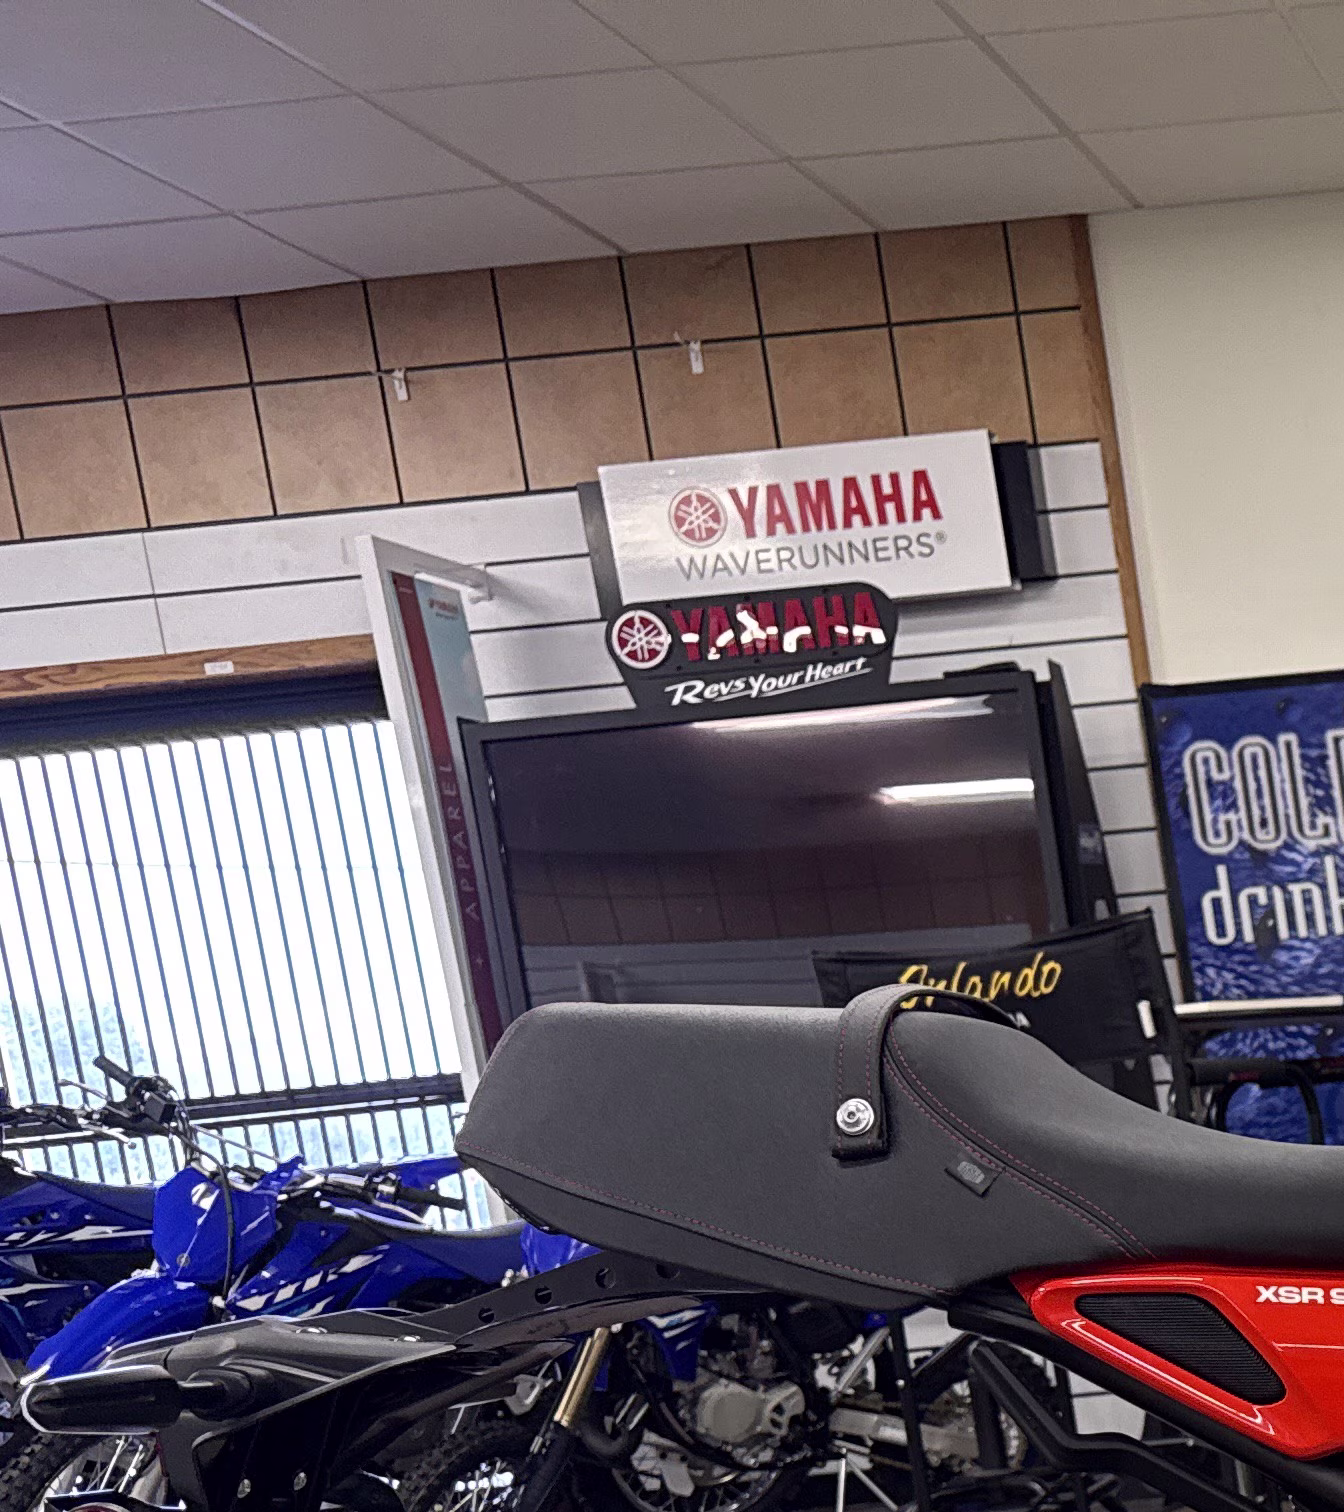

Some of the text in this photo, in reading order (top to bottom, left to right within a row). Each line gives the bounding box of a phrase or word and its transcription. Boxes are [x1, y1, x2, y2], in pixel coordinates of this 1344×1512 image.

[727, 468, 943, 540] YAMAHA
[671, 591, 886, 663] YAMAHA
[803, 657, 867, 685] Heart
[1255, 1285, 1325, 1305] XSR
